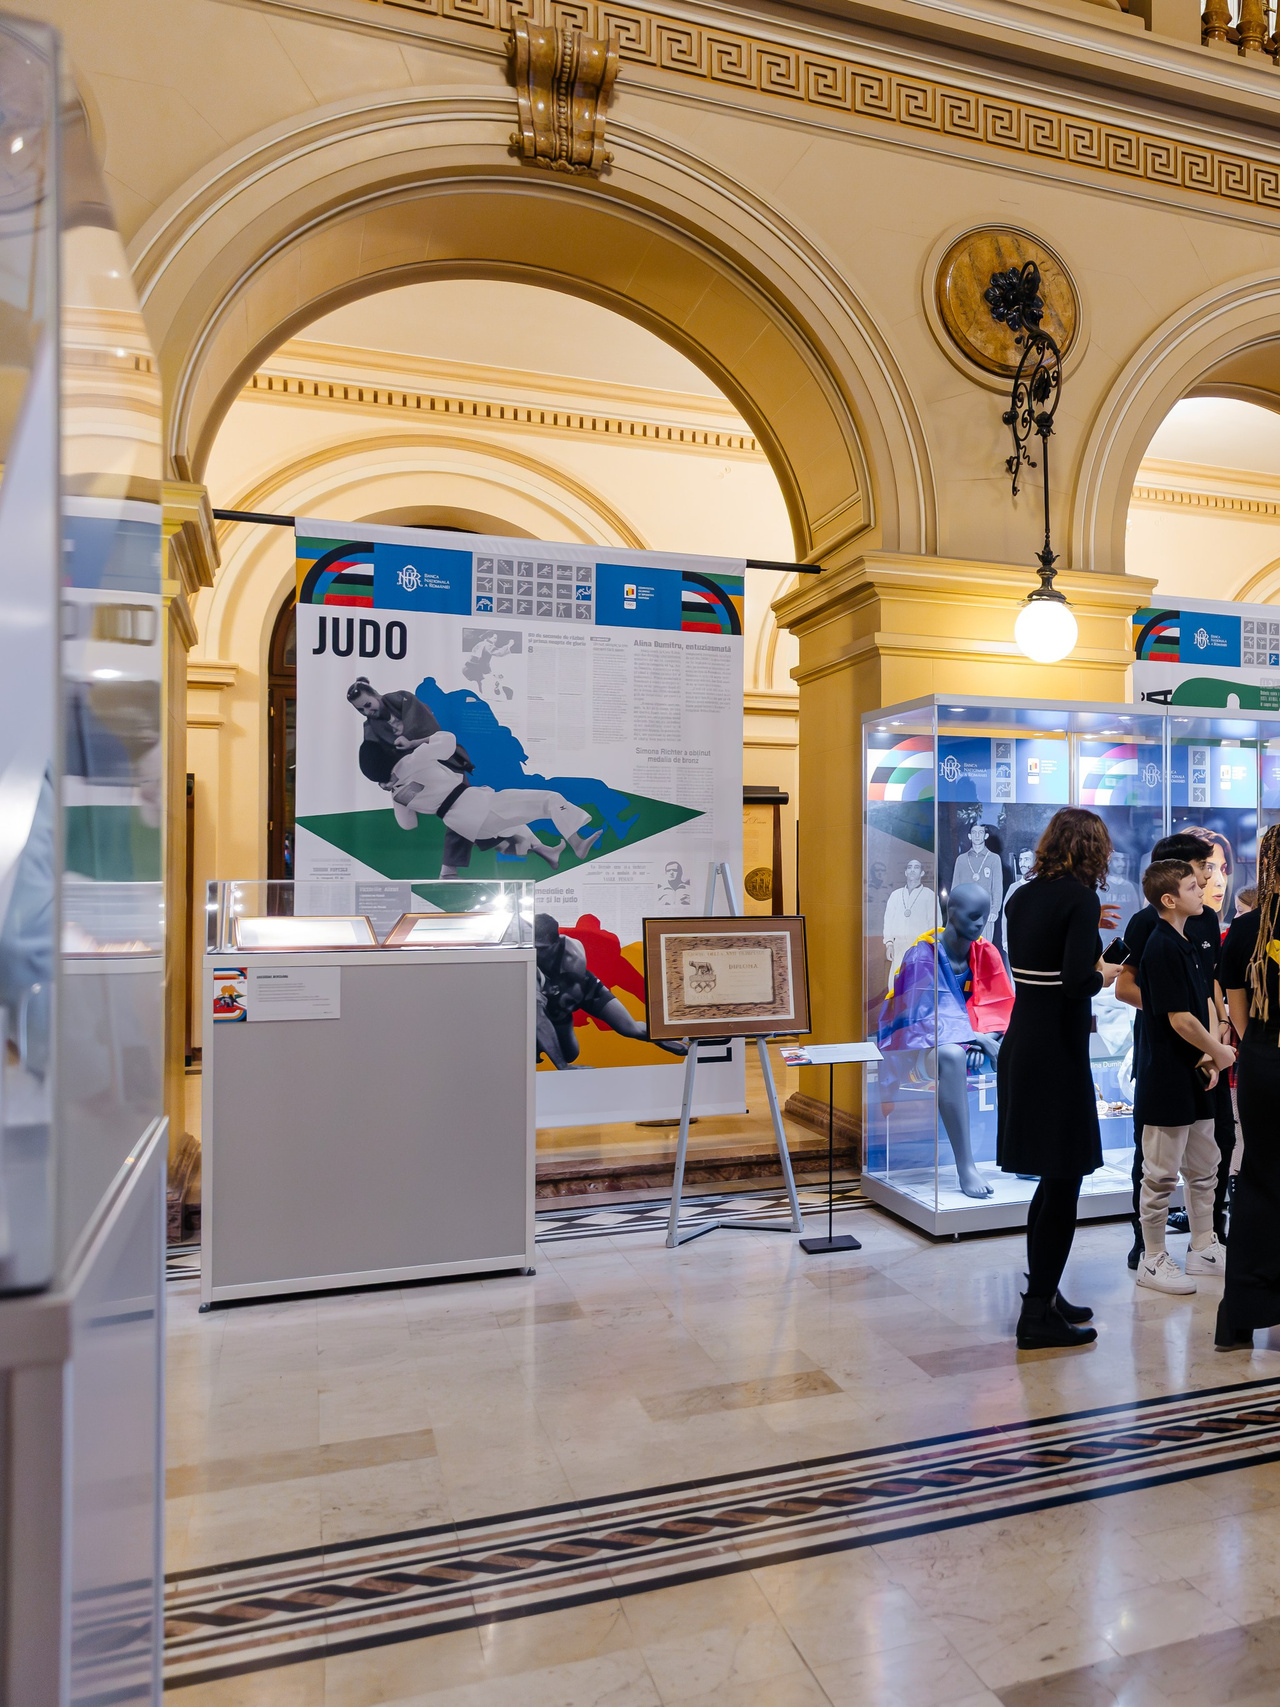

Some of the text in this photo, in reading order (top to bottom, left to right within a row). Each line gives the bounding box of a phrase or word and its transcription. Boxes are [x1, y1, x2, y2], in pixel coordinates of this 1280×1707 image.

[312, 615, 407, 660] JUDO
[633, 639, 652, 648] Alina
[653, 640, 684, 651] Dumitru,
[685, 643, 732, 653] entuziasmată
[635, 747, 659, 755] Simona
[660, 748, 683, 756] Richter
[672, 756, 681, 764] de
[535, 887, 575, 895] medalie de
[562, 896, 578, 904] judo
